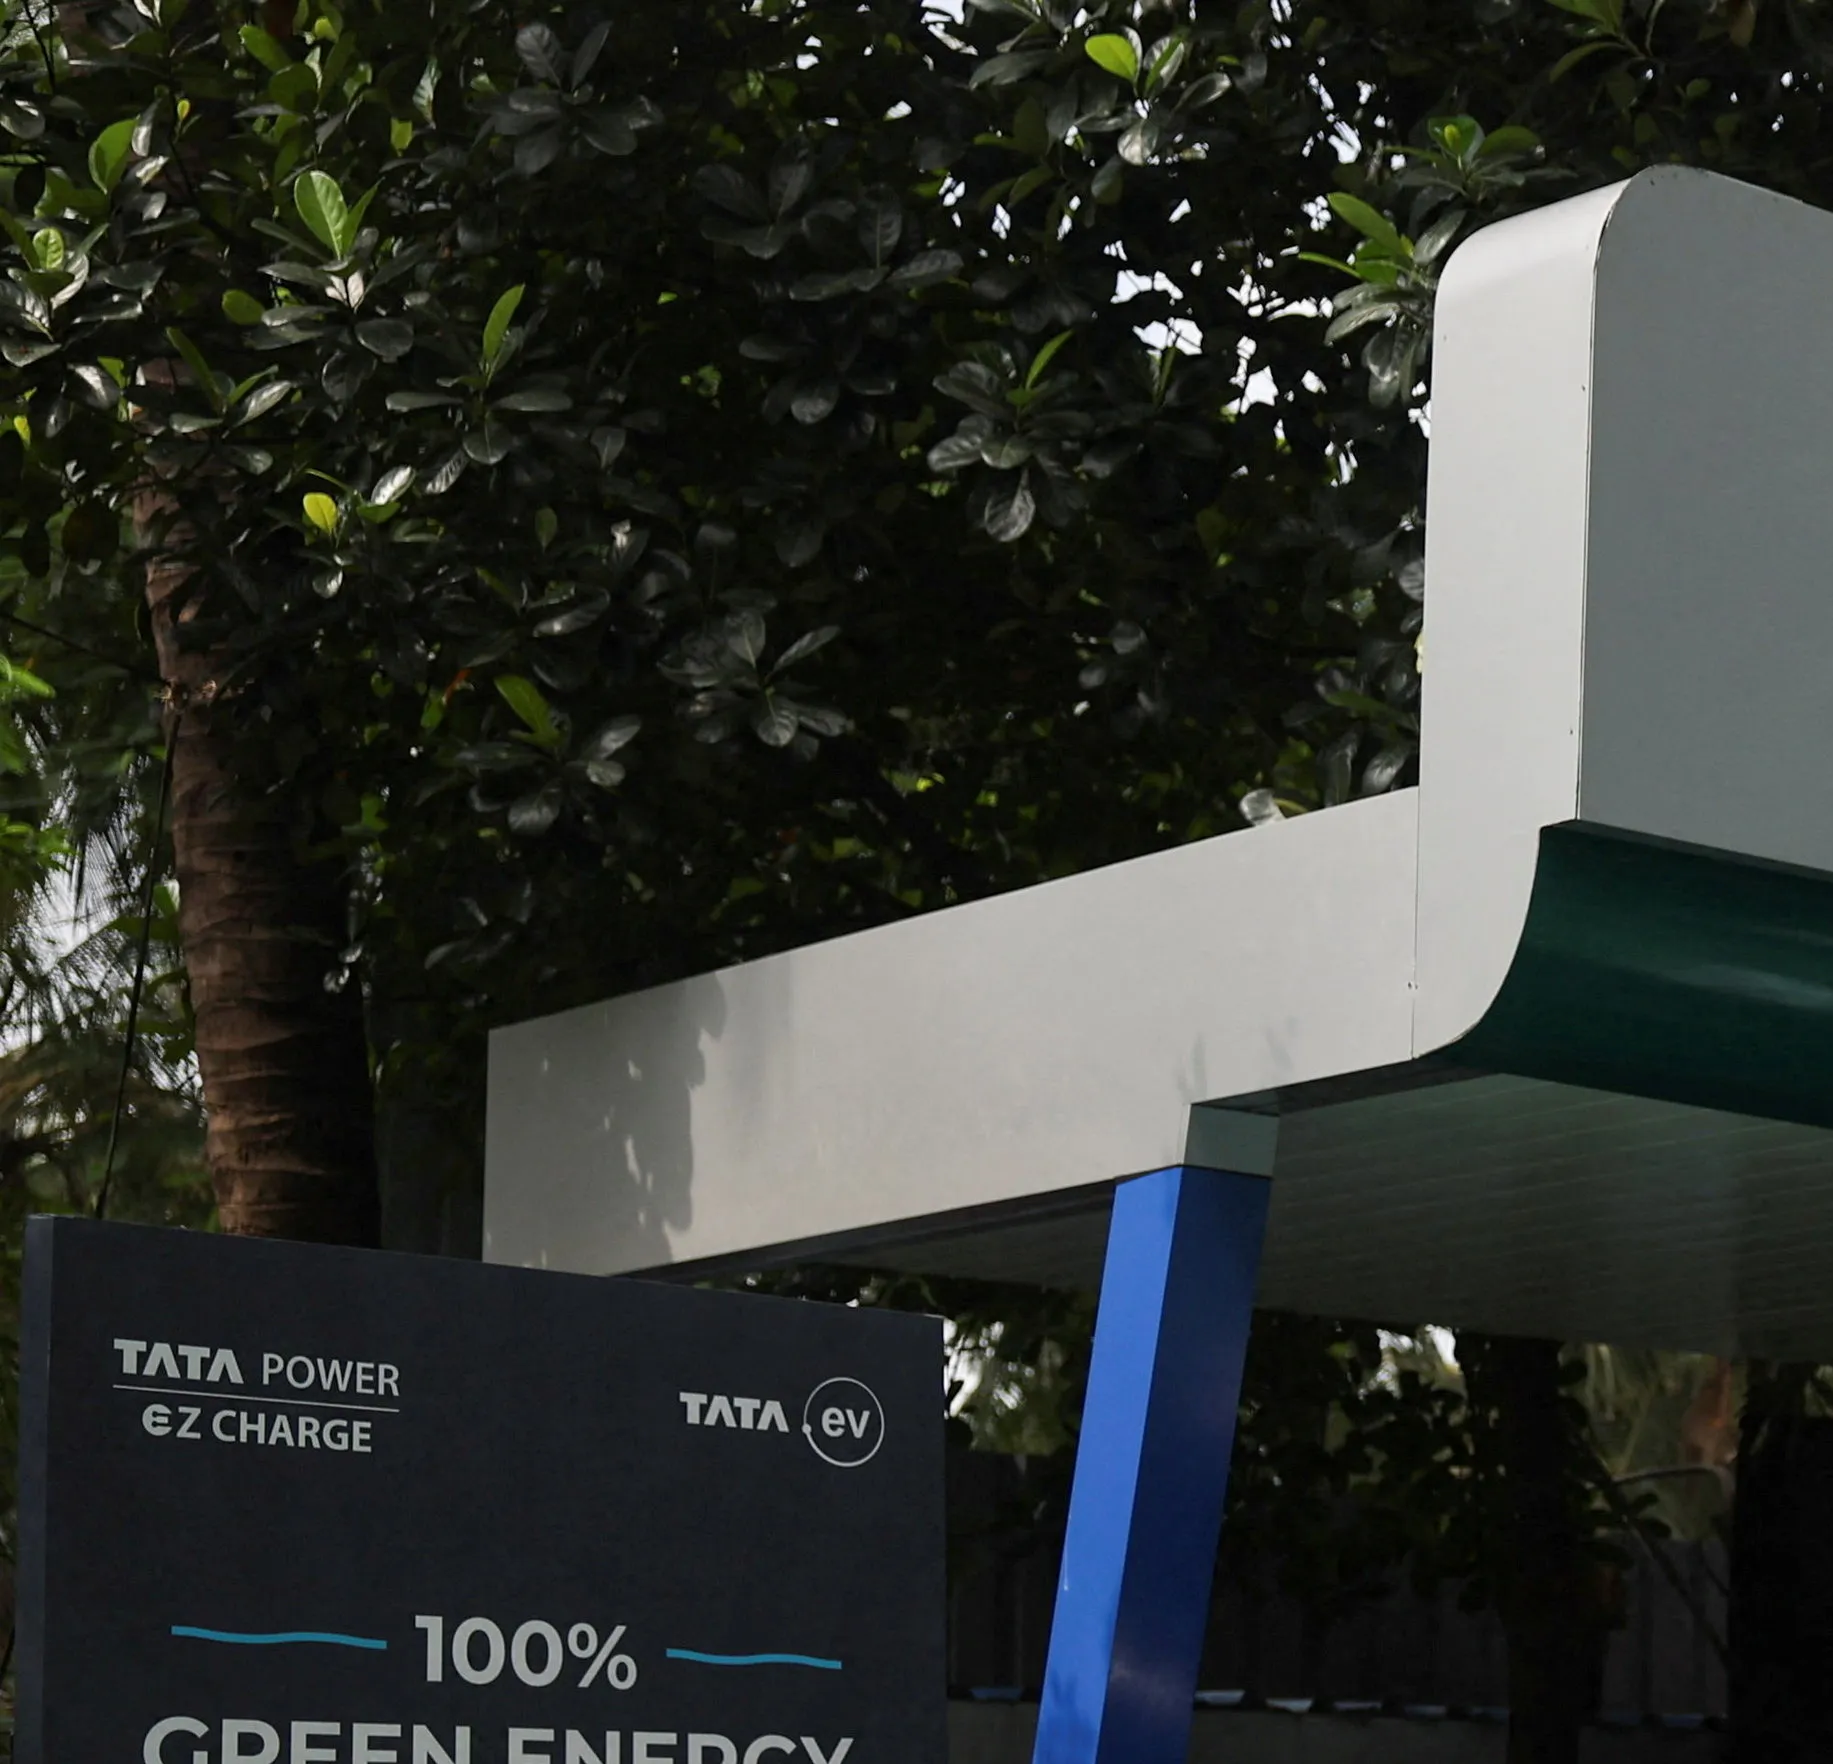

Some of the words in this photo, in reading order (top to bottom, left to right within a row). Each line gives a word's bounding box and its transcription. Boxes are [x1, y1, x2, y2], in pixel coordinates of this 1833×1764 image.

[113, 1338, 244, 1385] TATA
[262, 1353, 400, 1397] POWER
[212, 1408, 373, 1453] CHARGE
[679, 1391, 790, 1433] TATA
[415, 1614, 637, 1690] 100%
